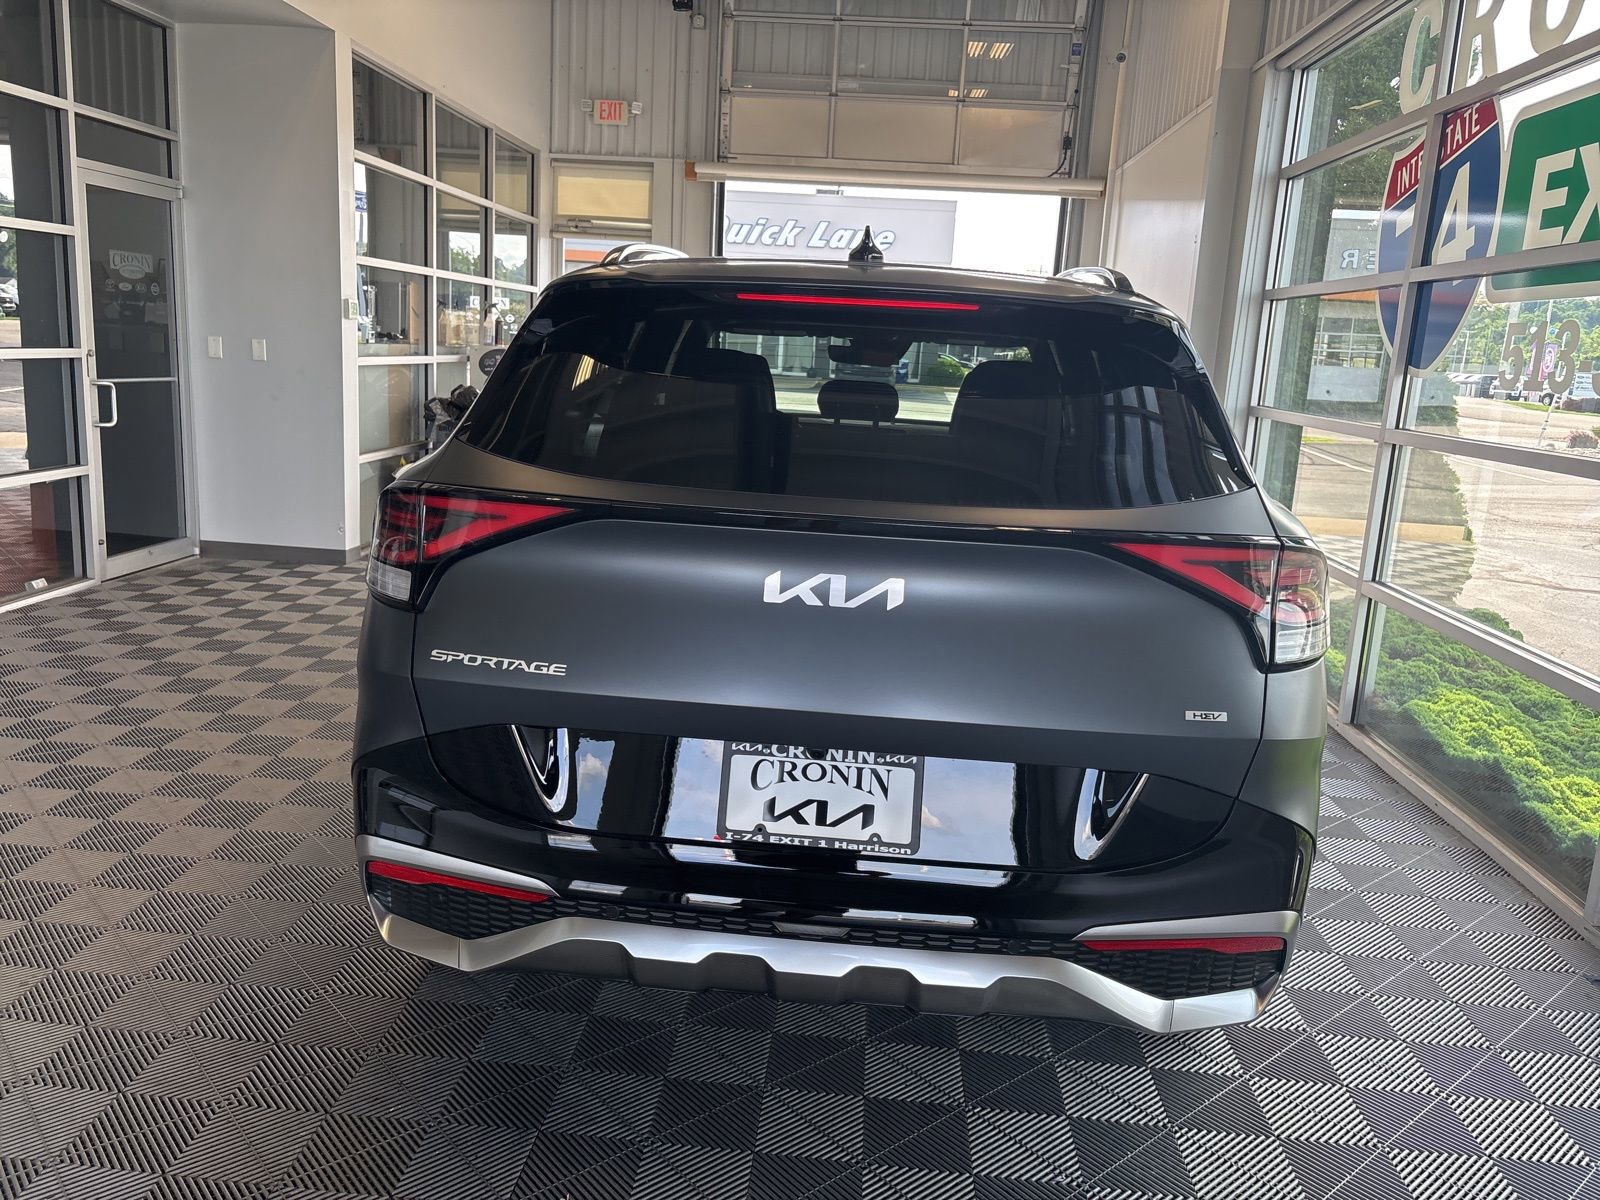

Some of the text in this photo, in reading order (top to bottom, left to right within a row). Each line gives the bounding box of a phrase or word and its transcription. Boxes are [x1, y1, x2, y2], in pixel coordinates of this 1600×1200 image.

[600, 101, 624, 120] EXIT
[725, 215, 804, 247] uick
[763, 570, 905, 611] KIA
[430, 649, 567, 676] SPORTAGE
[1192, 712, 1222, 720] HEV
[750, 758, 893, 802] CRONIN
[762, 796, 875, 830] KIA
[725, 831, 912, 856] I-74 EXIT 1 Harrison
